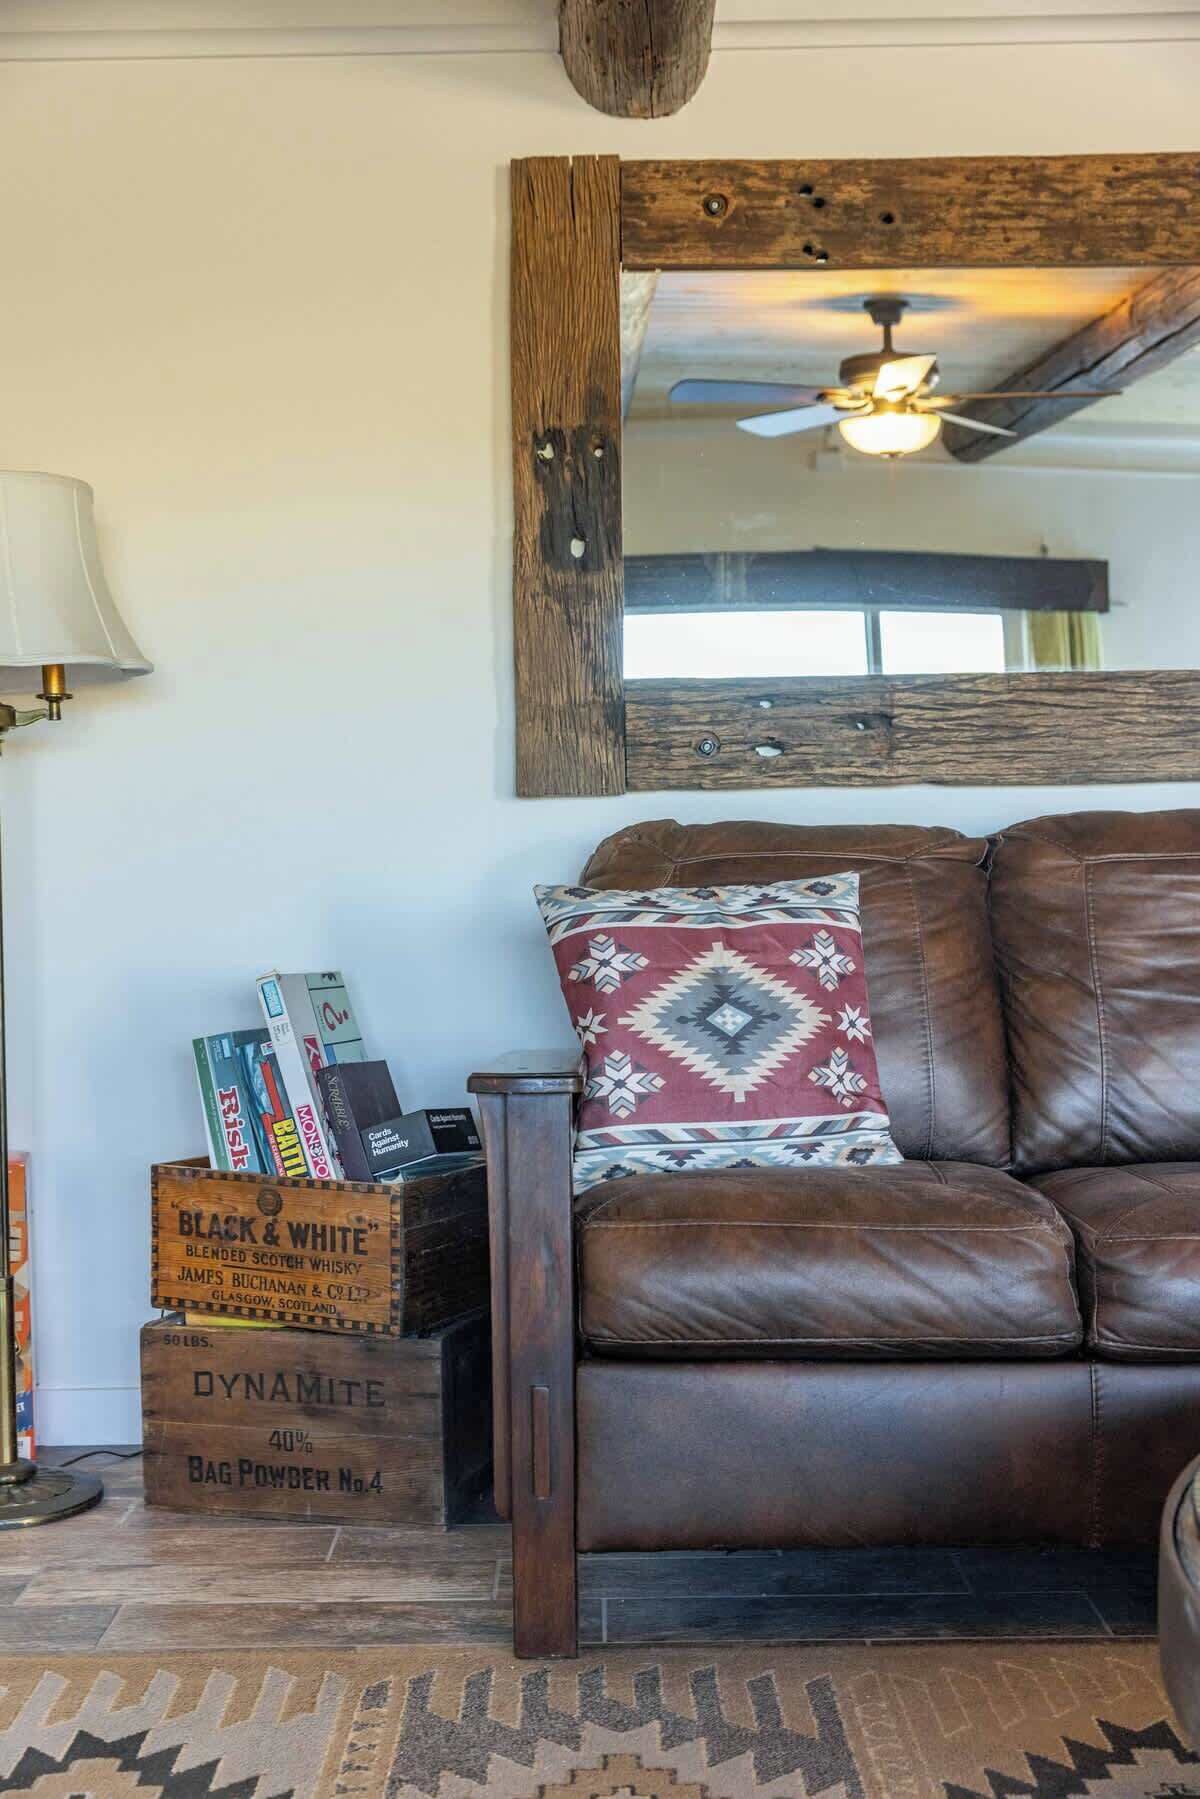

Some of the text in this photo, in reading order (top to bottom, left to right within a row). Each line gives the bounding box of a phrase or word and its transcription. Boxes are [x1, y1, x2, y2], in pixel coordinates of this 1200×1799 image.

[218, 1086, 250, 1171] Risk
[297, 1105, 330, 1179] MONOPO
[368, 1128, 392, 1141] Cards
[371, 1133, 401, 1149] Against
[372, 1139, 409, 1156] Humanity
[262, 1219, 280, 1246] &
[185, 1244, 362, 1275] BLENDED SCOTCH WHISKY
[177, 1265, 224, 1286] JAMES
[231, 1272, 306, 1296] BUCHANAN
[311, 1284, 322, 1298] &
[163, 1334, 214, 1348] 50 LBS.
[193, 1370, 385, 1408] DYNAMITE
[268, 1429, 313, 1454] 40%
